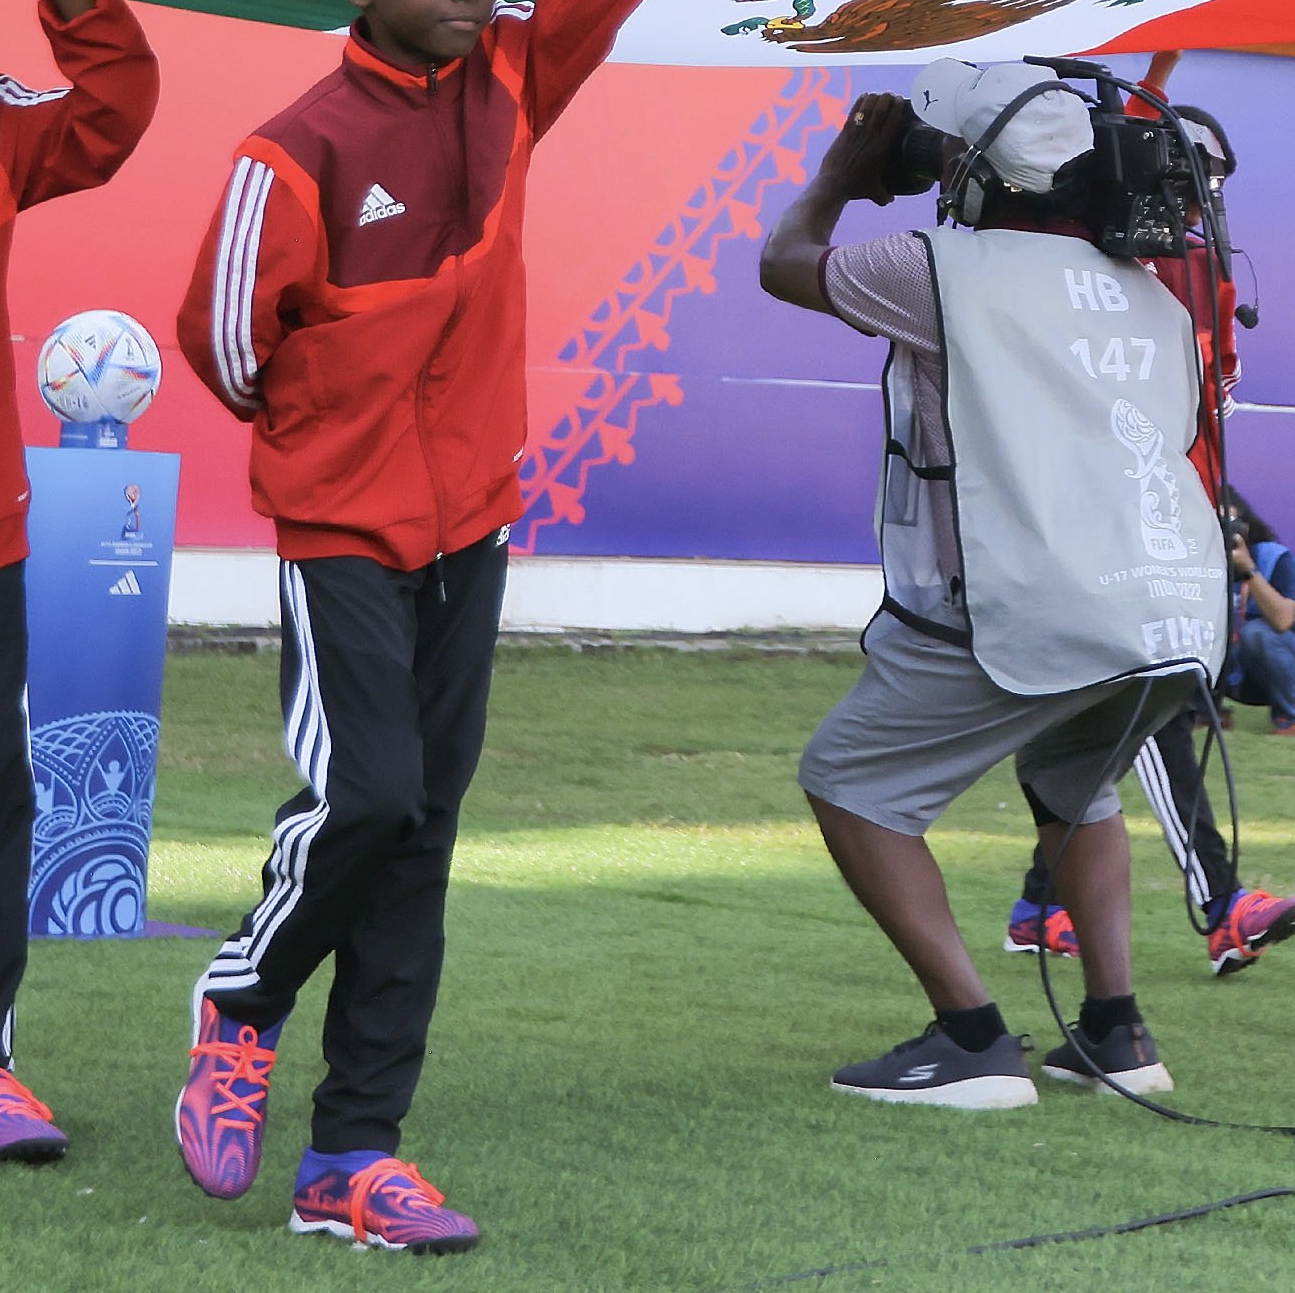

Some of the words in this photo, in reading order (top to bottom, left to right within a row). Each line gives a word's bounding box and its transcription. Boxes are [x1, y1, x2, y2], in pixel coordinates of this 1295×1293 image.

[359, 202, 406, 226] adidas
[1064, 268, 1130, 312] HB
[1069, 337, 1157, 381] 147
[1150, 538, 1176, 551] FIFA
[1099, 570, 1127, 585] U-17
